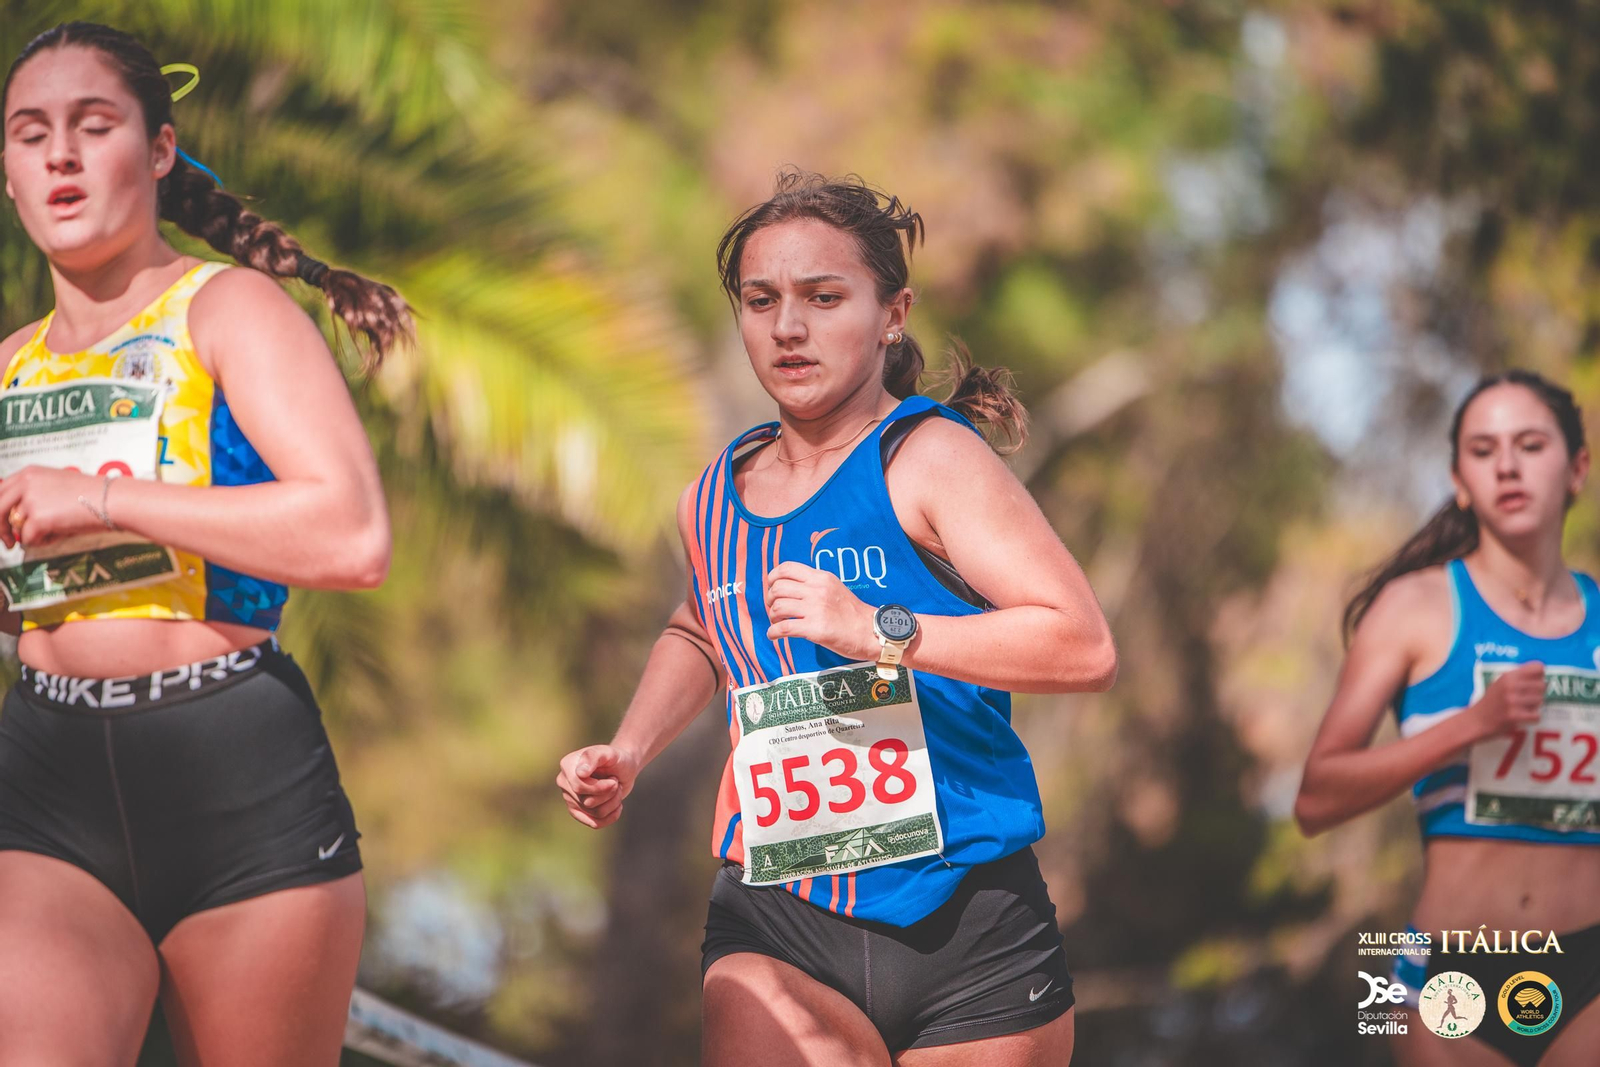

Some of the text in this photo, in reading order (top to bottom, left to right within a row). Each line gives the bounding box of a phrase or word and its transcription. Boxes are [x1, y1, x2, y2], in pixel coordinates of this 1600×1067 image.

[6, 389, 96, 425] ITÁLICA
[882, 616, 909, 627] 10:12
[34, 646, 263, 708] NIKE PRO
[769, 678, 855, 712] ITÁLICA
[828, 699, 857, 708] COUNTRY
[780, 735, 798, 743] Centro
[798, 730, 827, 740] desportivo
[835, 723, 865, 734] Quarteira
[785, 718, 840, 734] Santos, Ana Rita
[749, 738, 917, 828] 5538
